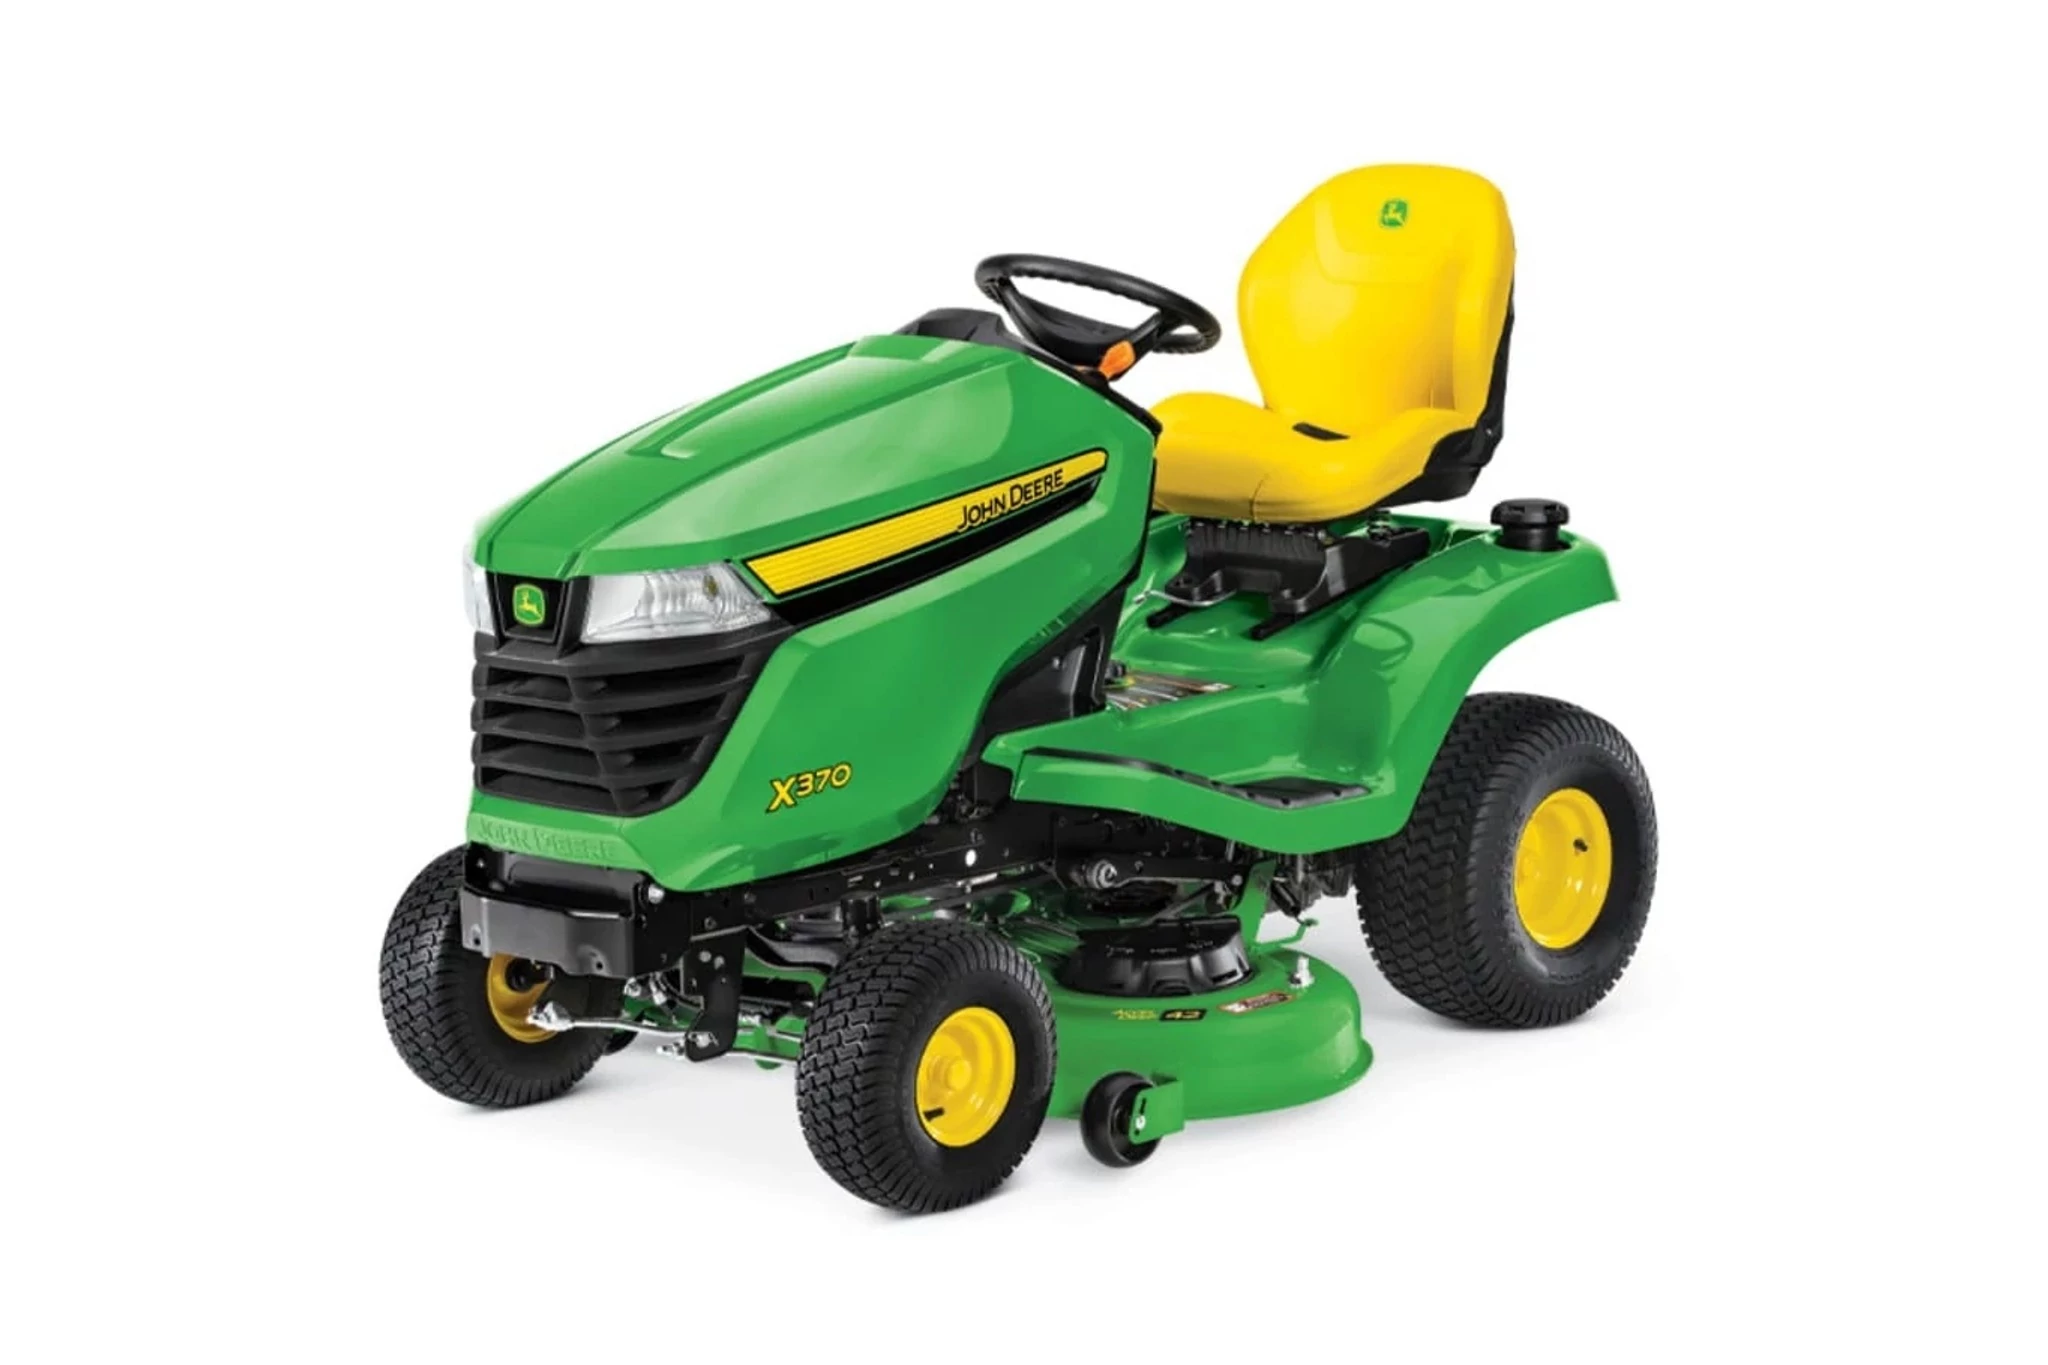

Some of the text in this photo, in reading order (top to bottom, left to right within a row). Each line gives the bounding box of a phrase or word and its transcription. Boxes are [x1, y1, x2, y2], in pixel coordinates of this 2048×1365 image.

[957, 468, 1064, 530] JOHN DEERE
[766, 762, 852, 813] X370
